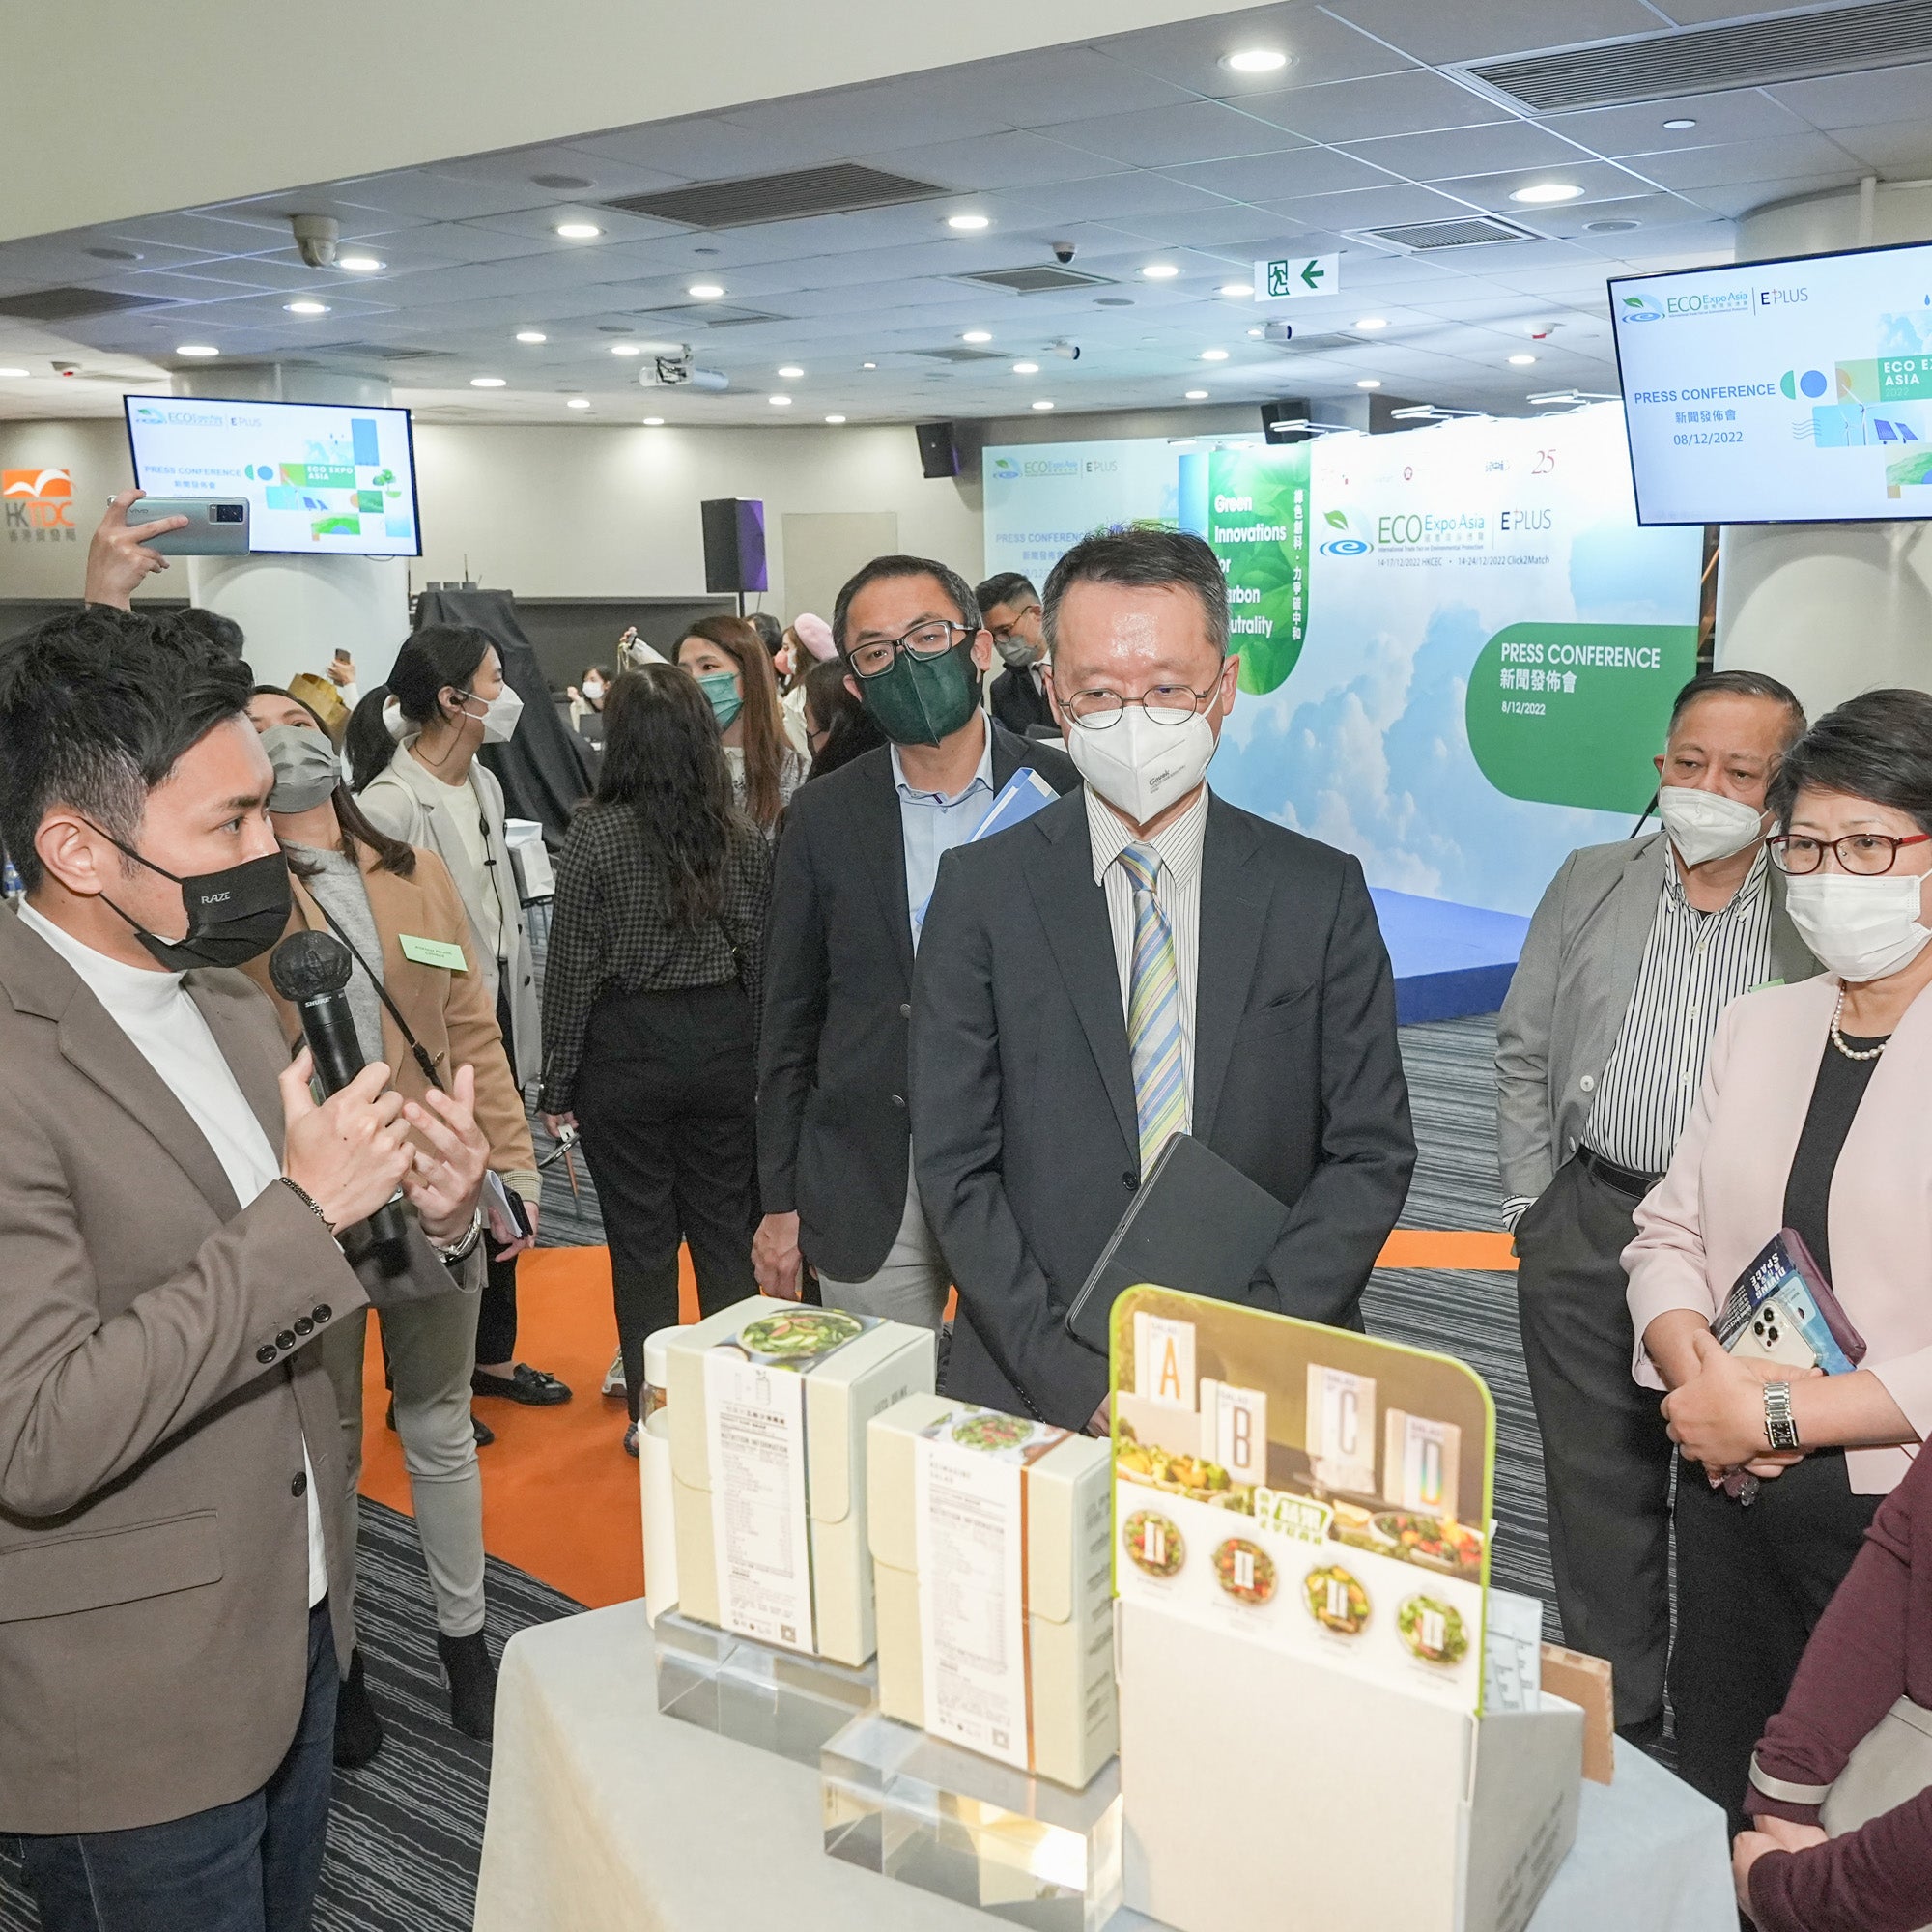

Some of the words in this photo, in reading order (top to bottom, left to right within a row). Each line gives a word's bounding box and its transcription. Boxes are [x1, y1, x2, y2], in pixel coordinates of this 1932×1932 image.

[1667, 295, 1702, 313] ECO
[1703, 294, 1727, 305] Expo
[1727, 291, 1747, 301] Asia
[1884, 360, 1915, 374] ECO
[1885, 373, 1920, 386] ASIA
[1634, 390, 1678, 404] PRESS
[1681, 384, 1776, 400] CONFERENCE
[168, 412, 192, 423] ECO
[1675, 409, 1737, 424] 新聞發佈會
[1673, 431, 1744, 445] 08/12/2022
[145, 466, 176, 474] PRESS
[179, 467, 242, 476] CONFERENCE
[1024, 460, 1048, 473] ECO
[1531, 449, 1556, 474] 25
[1214, 494, 1253, 514] Green
[5, 501, 77, 527] HKTDC
[1214, 523, 1288, 544] Innovations
[1378, 514, 1423, 544] ECO
[1425, 514, 1456, 535] Expo
[1459, 513, 1485, 530] Asia
[996, 533, 1026, 544] PRESS
[1217, 557, 1232, 573] or
[1458, 556, 1506, 566] 14-24/12/2022
[1507, 554, 1550, 565] Click2Match
[1227, 585, 1261, 604] arbon
[1231, 615, 1273, 638] utrality
[1501, 642, 1544, 664] PRESS
[1548, 644, 1661, 668] CONFERENCE
[1500, 668, 1577, 694] 新聞發佈會
[1501, 701, 1546, 716] 8/12/2022
[201, 891, 231, 904] RAZE
[1750, 1252, 1779, 1286] SPACE
[1160, 1336, 1180, 1400] A
[1234, 1406, 1252, 1469] B
